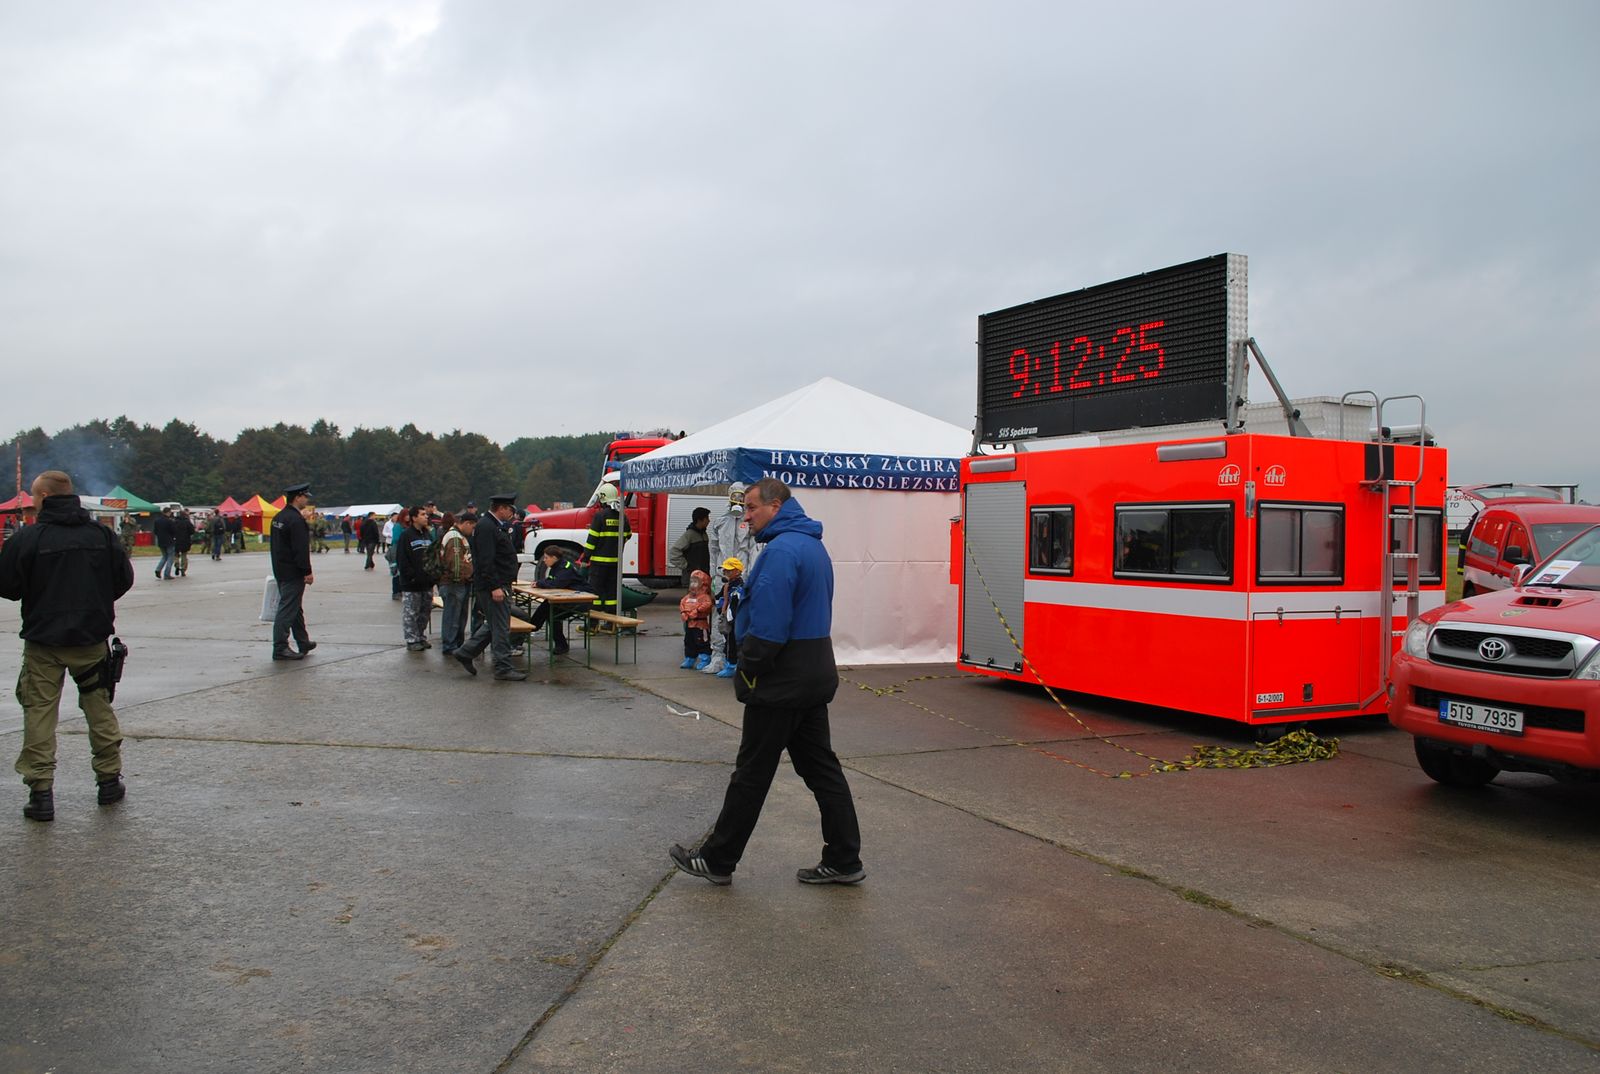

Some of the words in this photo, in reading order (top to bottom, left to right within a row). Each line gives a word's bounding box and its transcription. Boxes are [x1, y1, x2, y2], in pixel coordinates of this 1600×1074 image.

[1009, 320, 1165, 398] 9:12:25
[770, 452, 870, 470] HASIČSKÝ
[881, 456, 960, 473] ZÁCHRA
[1450, 703, 1473, 721] 5T9
[1483, 708, 1517, 728] 7935
